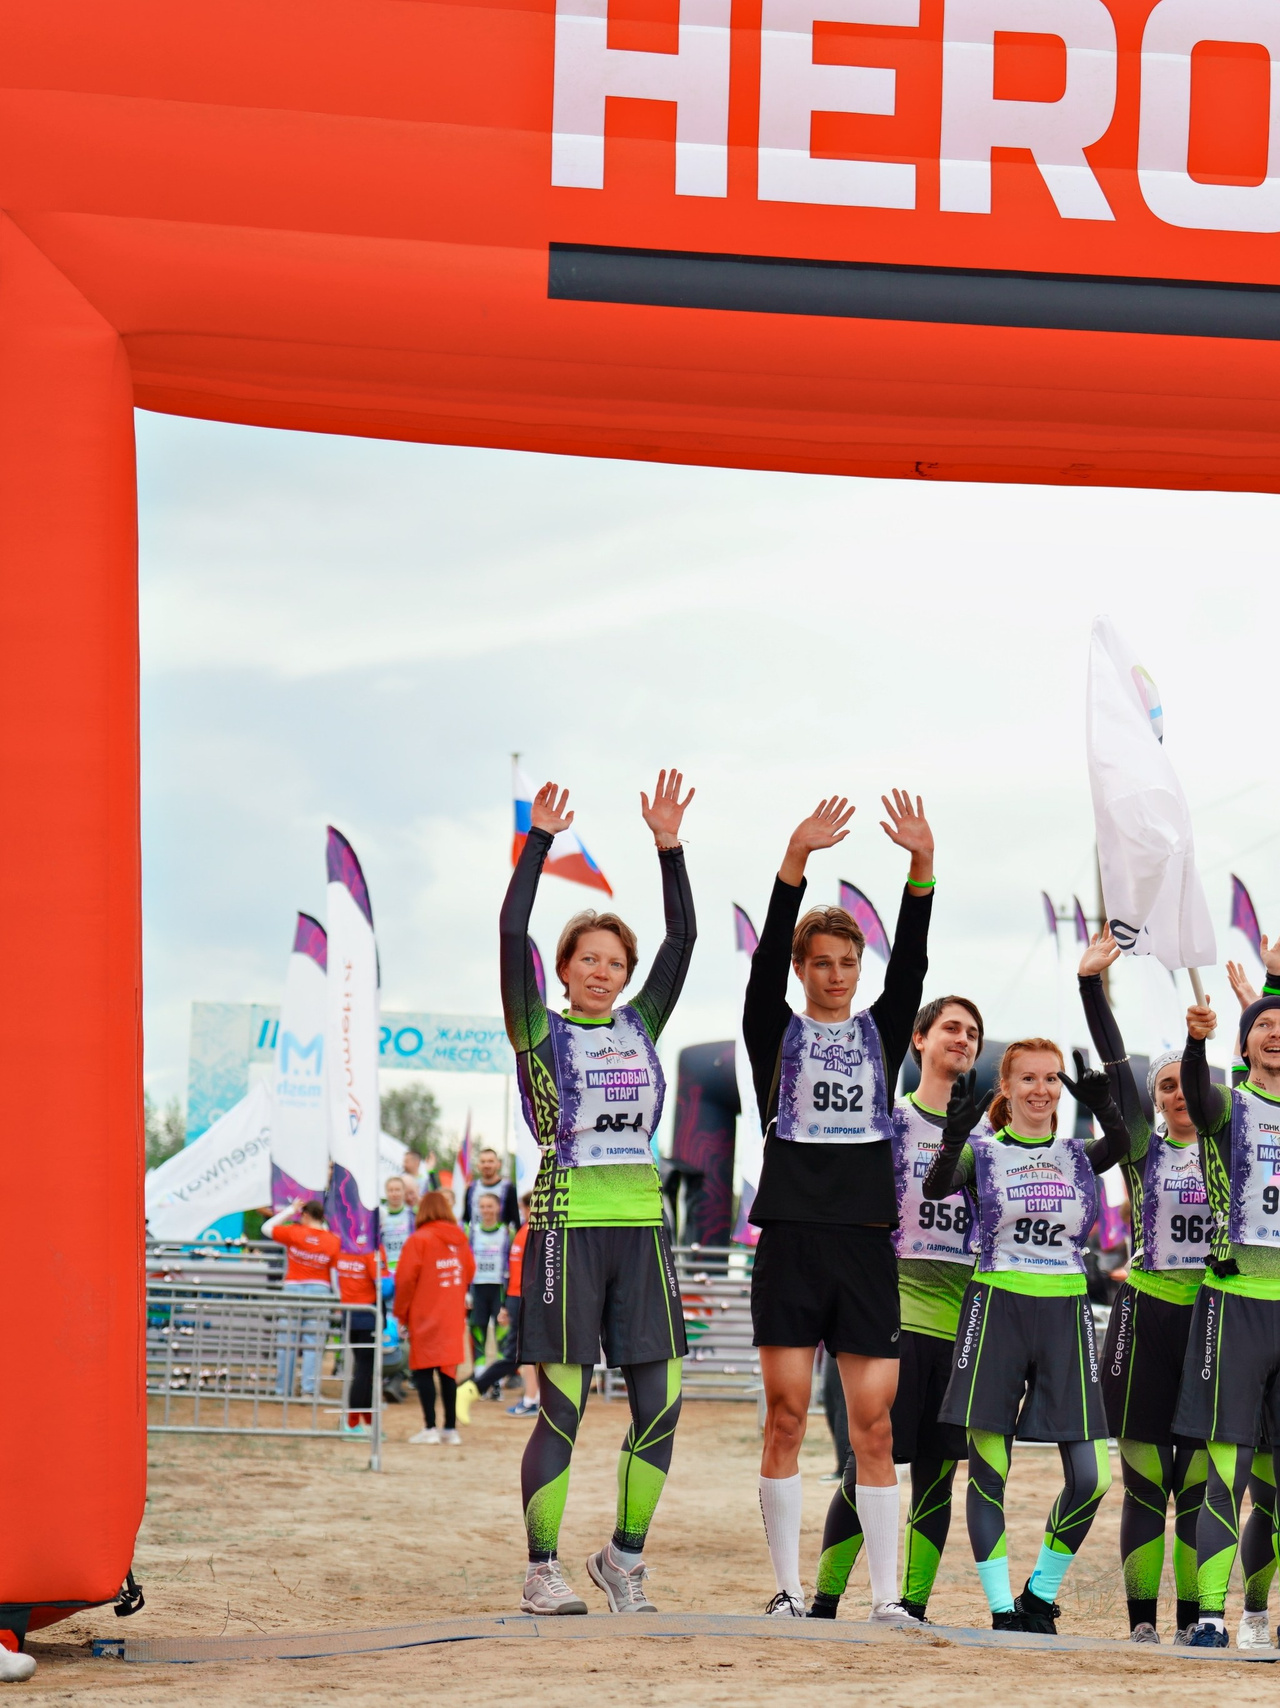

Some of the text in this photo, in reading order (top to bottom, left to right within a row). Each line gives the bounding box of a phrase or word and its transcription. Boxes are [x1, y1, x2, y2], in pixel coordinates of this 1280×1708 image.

[588, 1068, 648, 1086] МАССОВЫЙ
[607, 1087, 637, 1101] СТАРТ
[813, 1081, 864, 1113] 952
[823, 1126, 866, 1134] ГАЗПРОМБАНК
[917, 1141, 941, 1150] ГОНК
[1006, 1164, 1035, 1175] ГОНКА
[1009, 1184, 1074, 1199] МАССОВЫЙ
[1181, 1191, 1207, 1204] СТАР
[1027, 1199, 1060, 1211] СТАРТ
[918, 1201, 969, 1235] 958
[1013, 1217, 1066, 1247] 992
[1171, 1214, 1214, 1244] 962
[543, 1229, 557, 1304] Greenway
[1024, 1257, 1069, 1266] ГАЗПРОМБАНК
[1181, 1256, 1205, 1264] ГАЗПРО
[957, 1300, 981, 1369] Greenway
[1111, 1303, 1131, 1377] Greenway
[1201, 1307, 1215, 1380] Greenway
